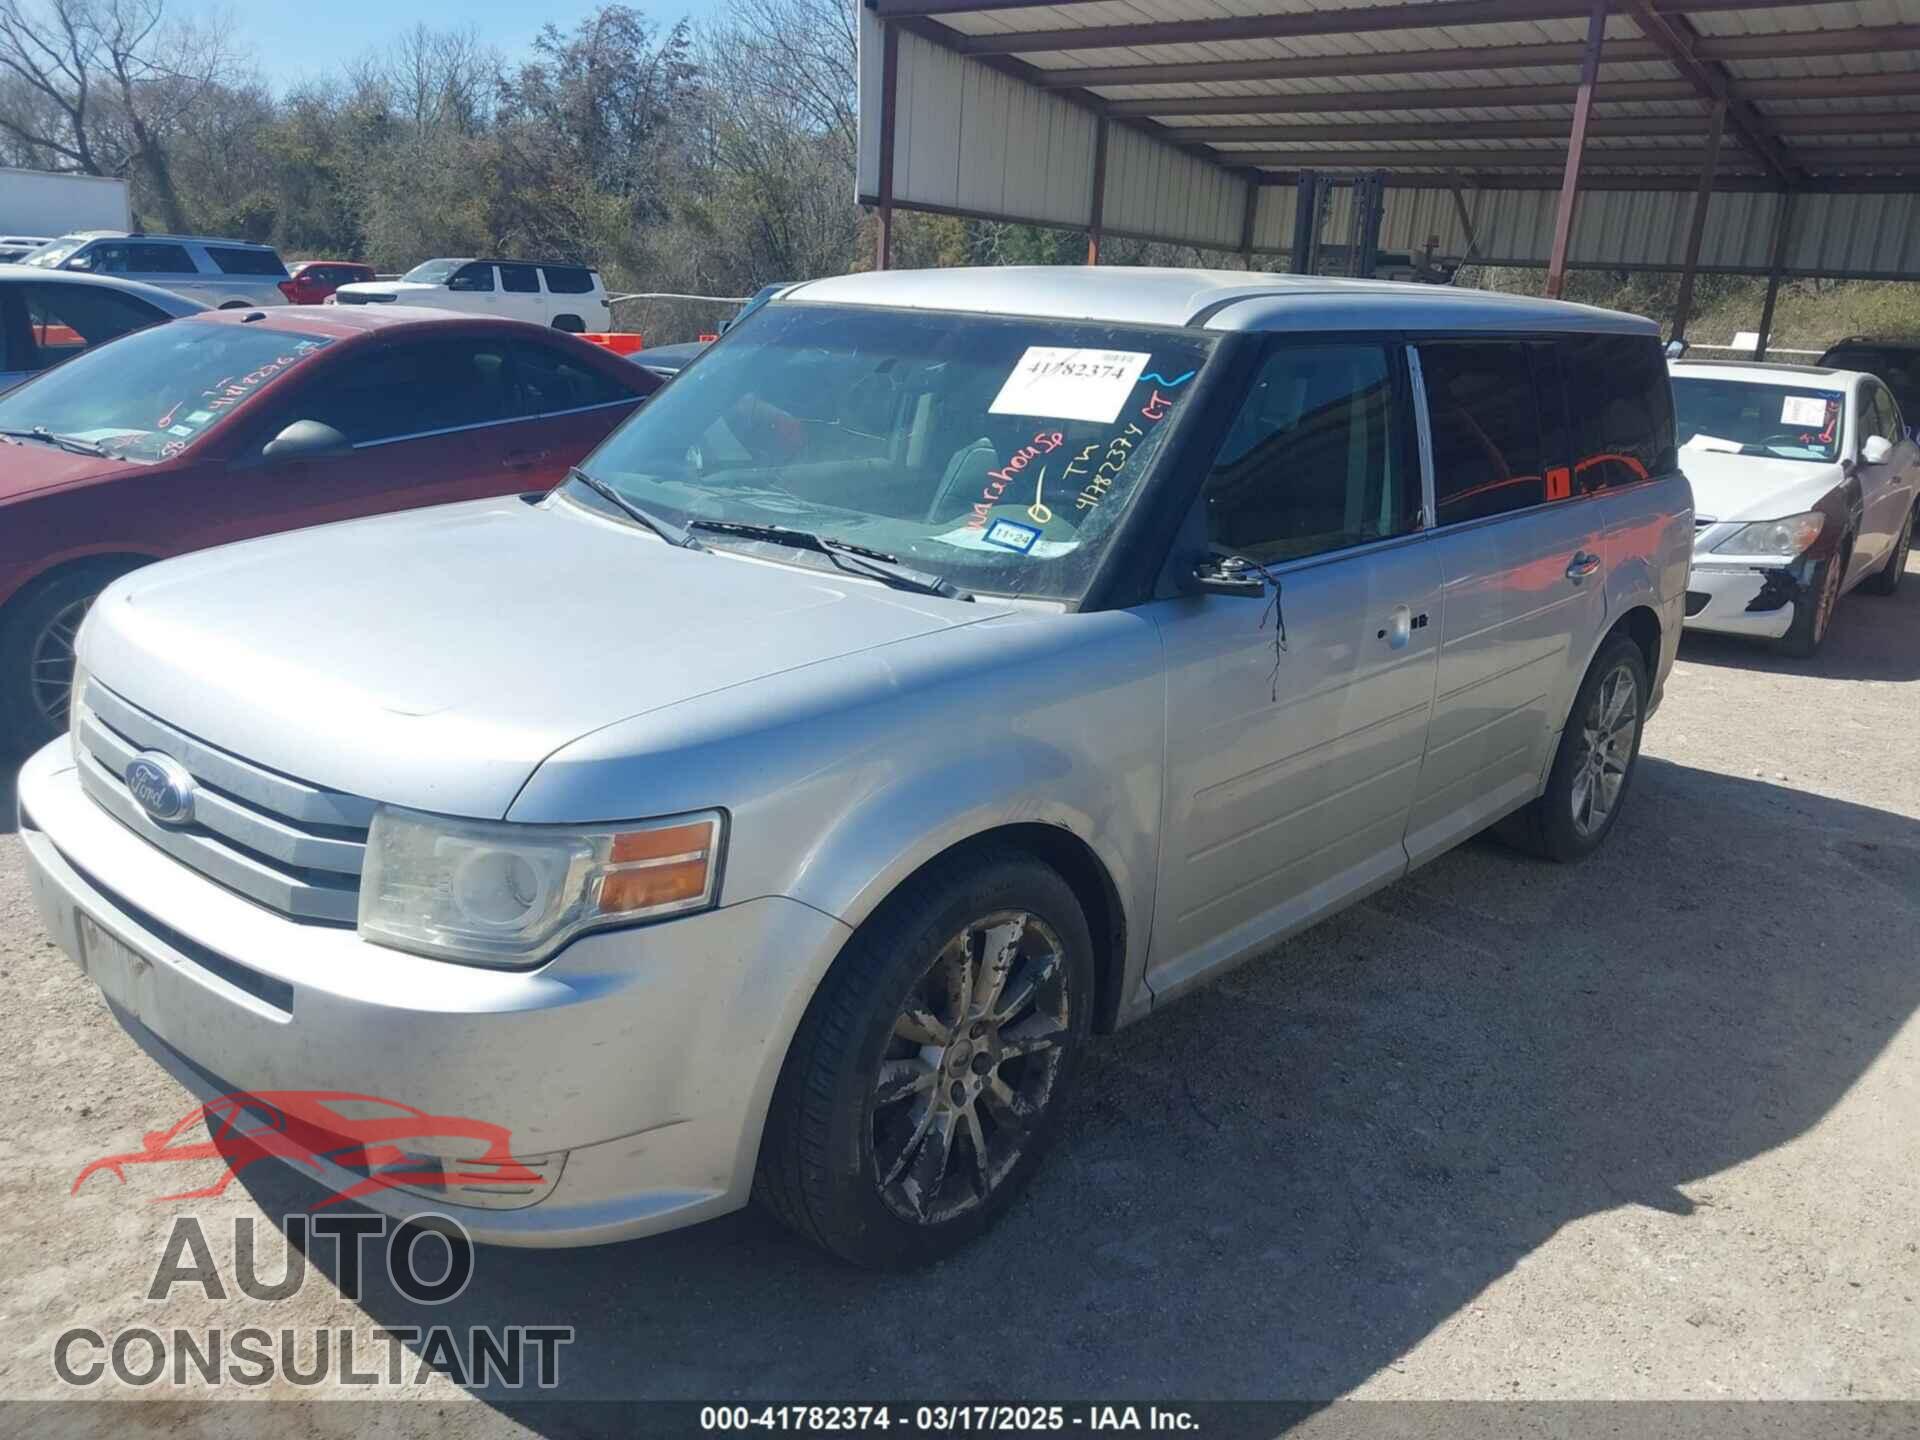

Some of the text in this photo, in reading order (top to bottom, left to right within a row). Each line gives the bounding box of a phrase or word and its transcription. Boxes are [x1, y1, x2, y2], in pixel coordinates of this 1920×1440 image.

[1026, 361, 1125, 380] 41782374
[1076, 423, 1143, 511] 41782374
[130, 764, 168, 809] Ford
